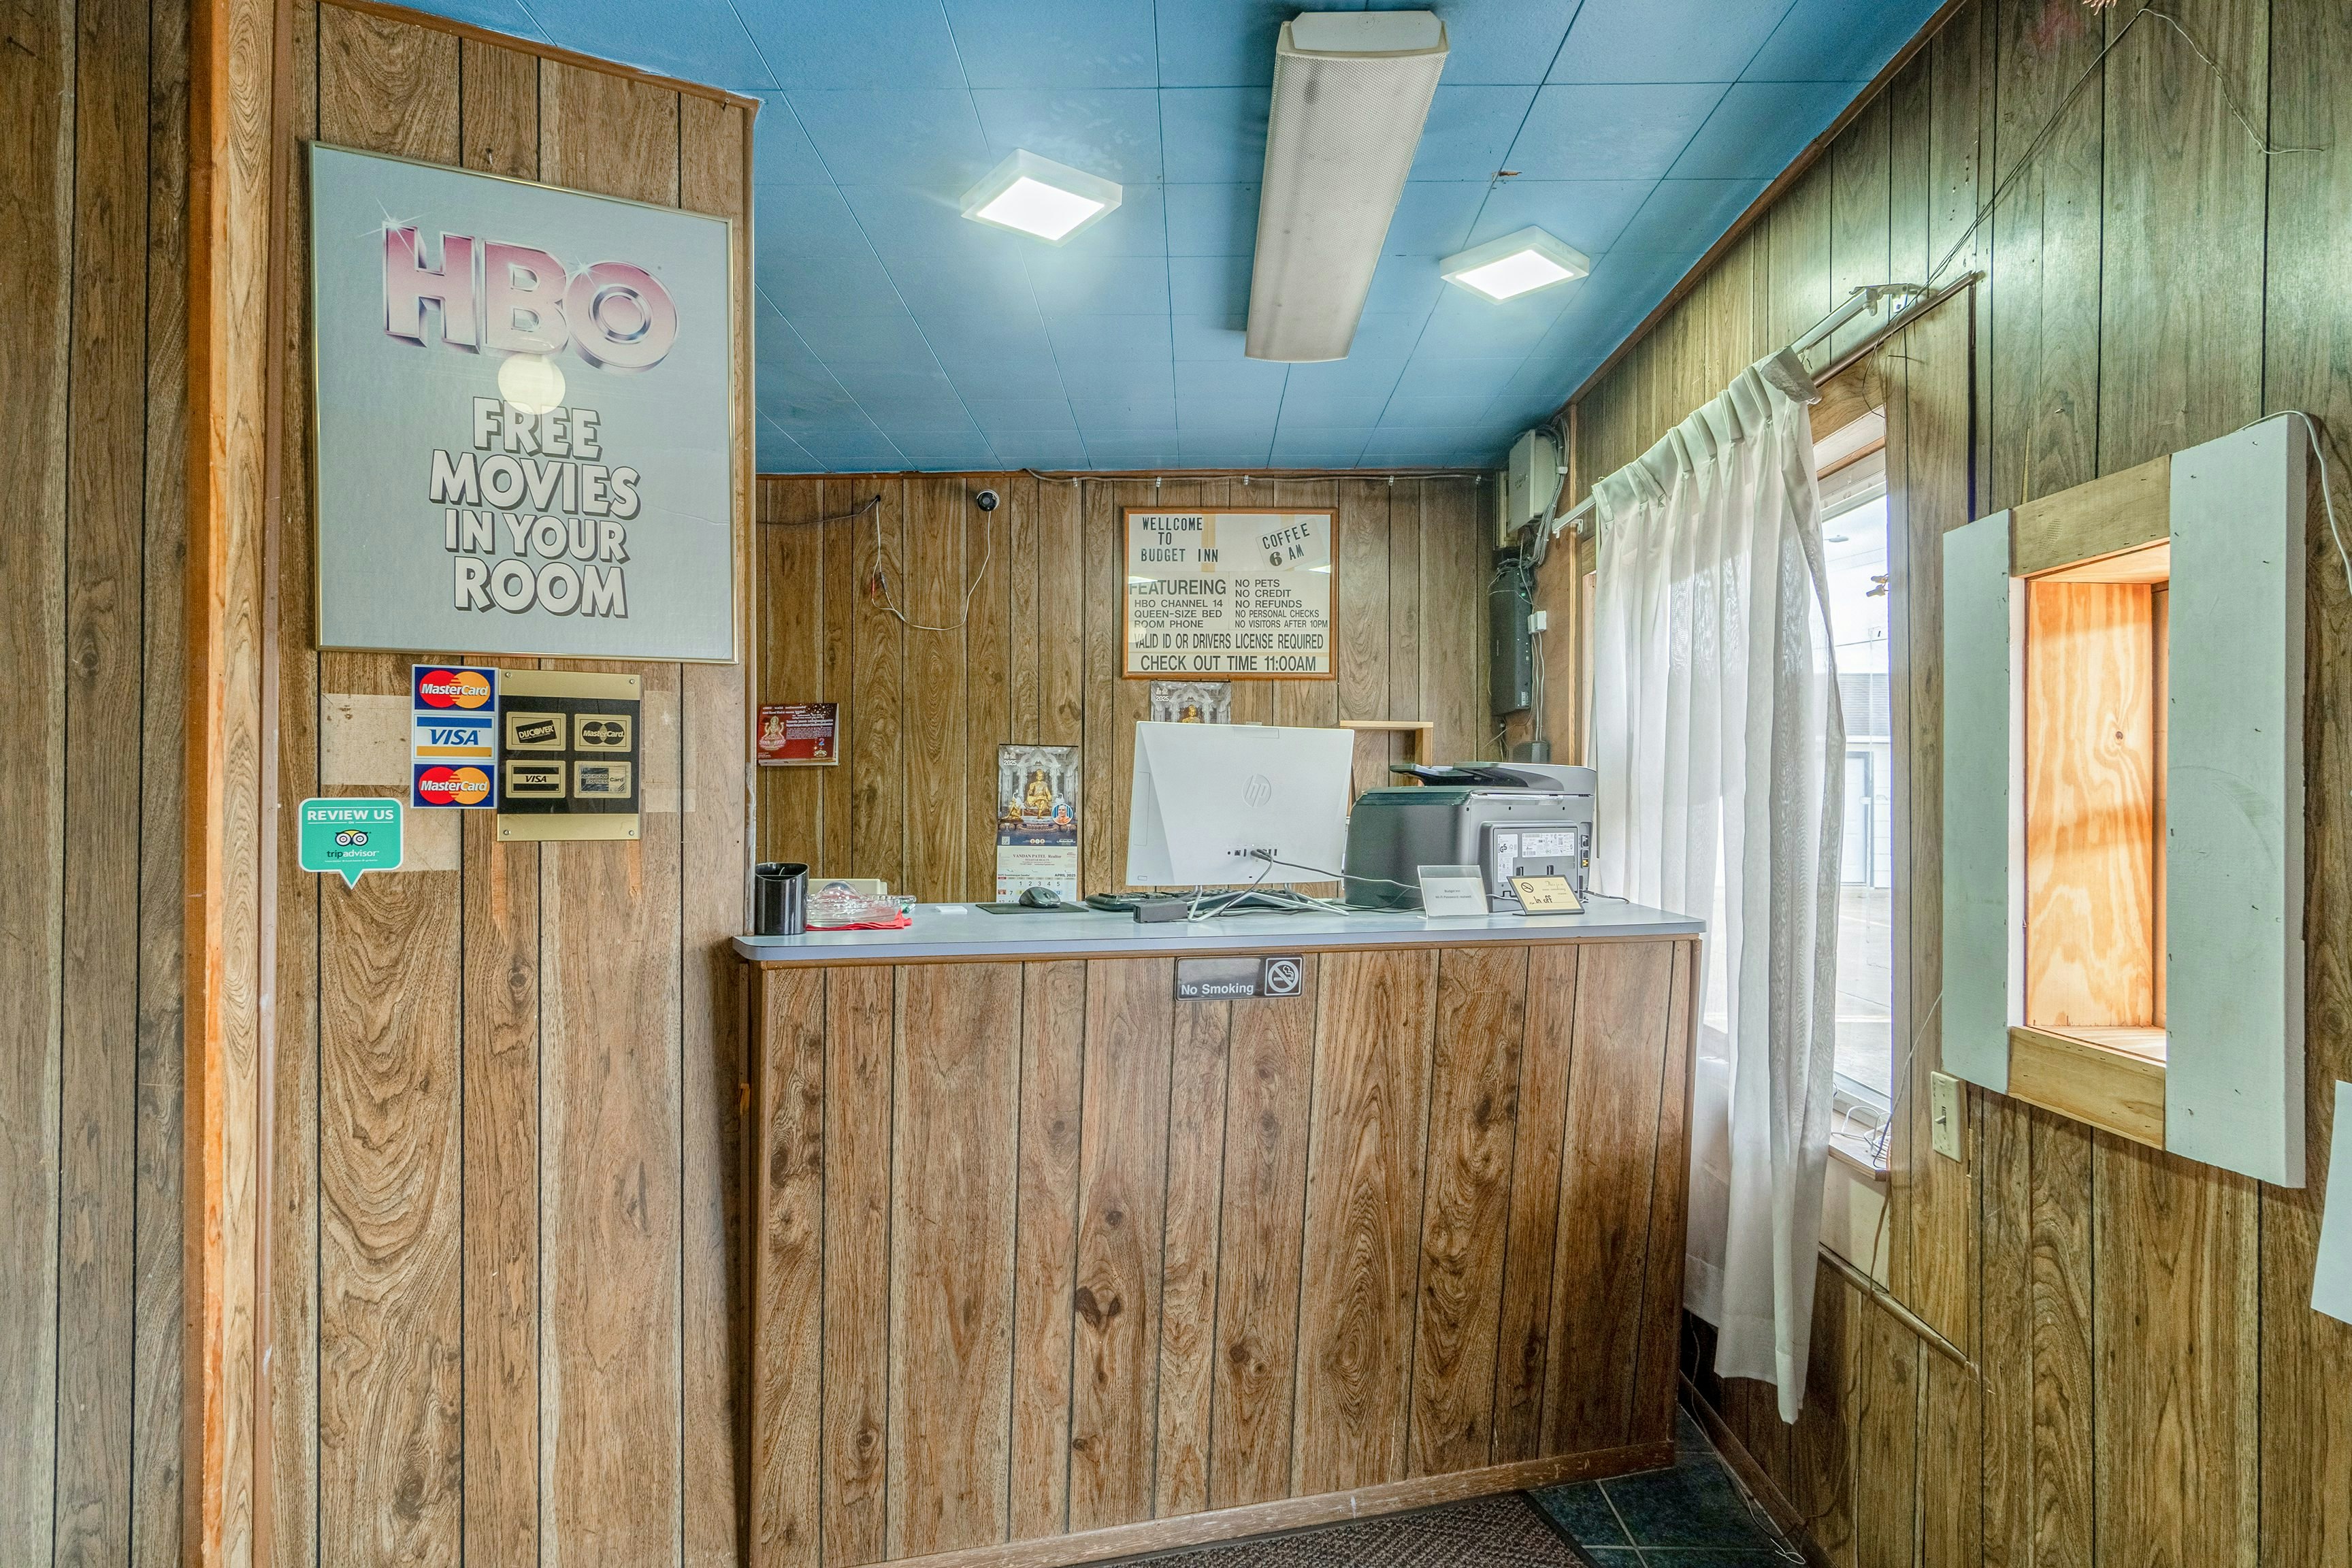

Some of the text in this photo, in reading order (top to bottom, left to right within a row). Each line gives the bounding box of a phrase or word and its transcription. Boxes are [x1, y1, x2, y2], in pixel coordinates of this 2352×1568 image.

[382, 221, 678, 372] HBO
[473, 396, 603, 461] FREE
[429, 449, 640, 521] MOVIES
[1142, 517, 1203, 531] WELLCOME
[445, 509, 630, 564] IN YOUR
[1158, 532, 1172, 545] TO
[1262, 523, 1309, 549] COFFEE
[1141, 549, 1218, 562] BUDGET INN
[1269, 544, 1304, 566] 6 AM
[455, 557, 628, 619] ROOM
[1129, 579, 1226, 595] FEATUREING
[1255, 589, 1291, 598] CREDIT
[1134, 610, 1196, 618] QUEEN-SIZE
[1235, 610, 1319, 618] NO PERSONAL CHECKS
[1170, 620, 1203, 628] PHONE
[1235, 620, 1328, 628] NO VISITORS AFTER 10PM
[1134, 634, 1323, 649] VALID ID OR DRIVERS LICENSE REQUIRED
[1141, 655, 1316, 671] CHECK OUT TIME 11:00AM
[421, 684, 489, 696] MasterCard
[429, 729, 479, 745] VISA
[519, 725, 554, 738] DISCOVER
[420, 781, 488, 791] MasterCard
[308, 810, 393, 820] REVIEW US
[327, 849, 376, 859] tripadvisor
[1181, 983, 1254, 995] No Smoking
